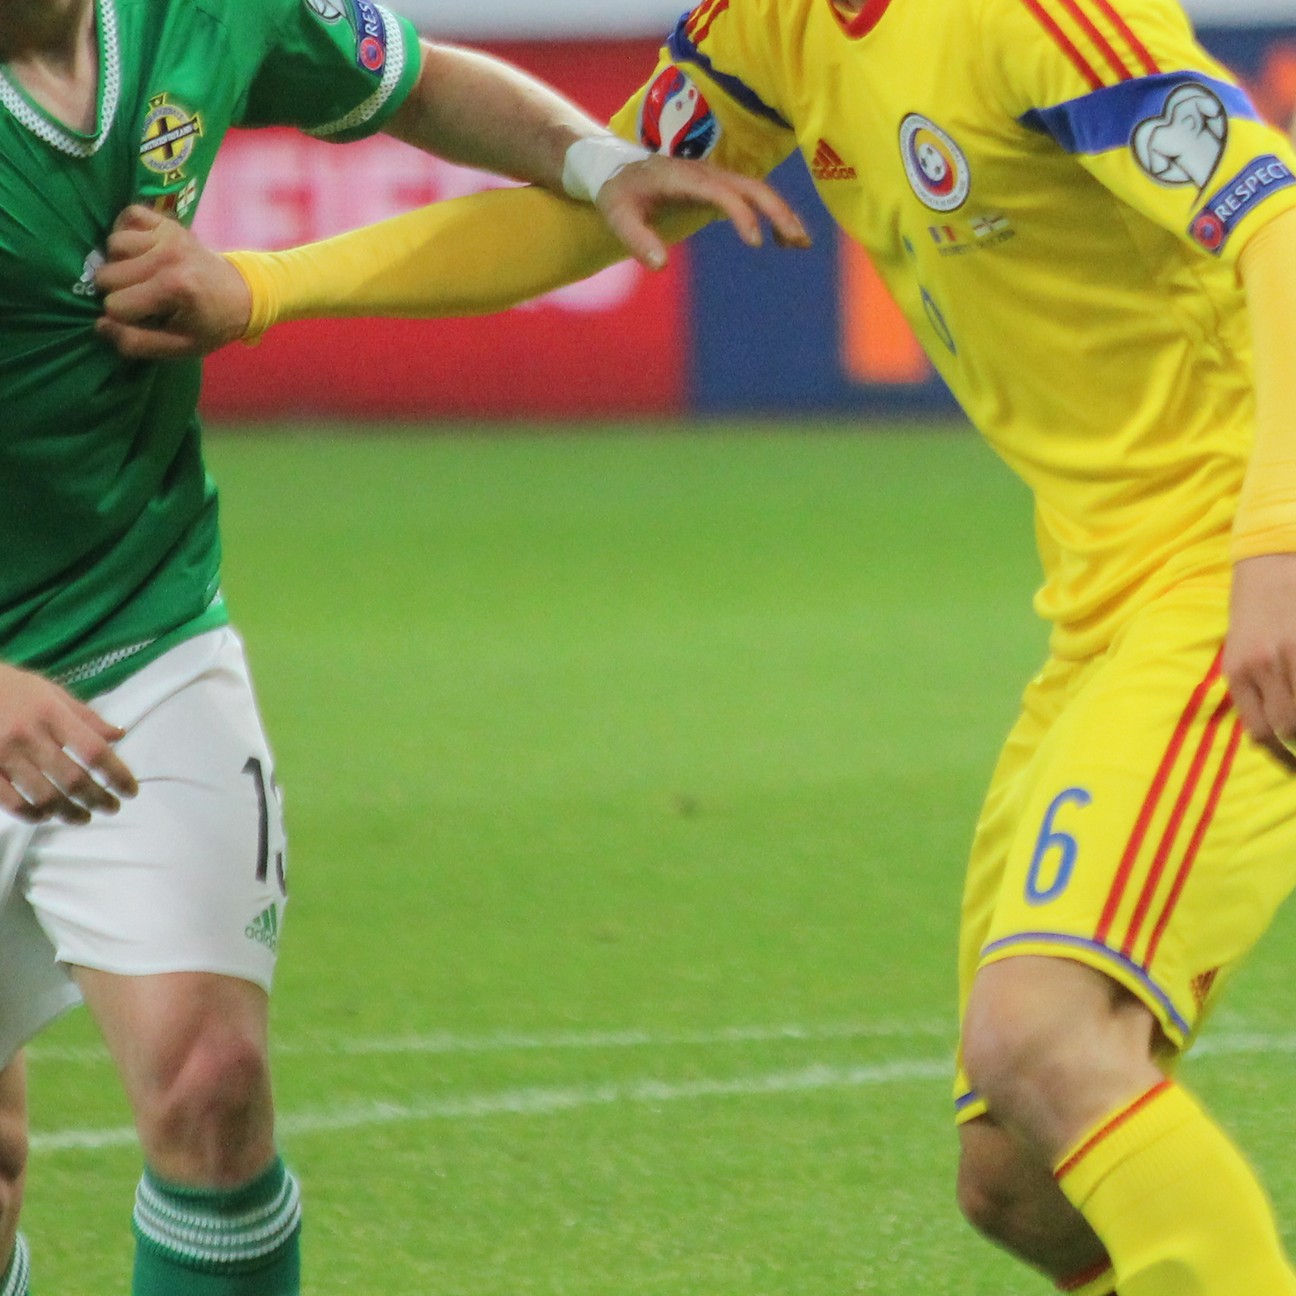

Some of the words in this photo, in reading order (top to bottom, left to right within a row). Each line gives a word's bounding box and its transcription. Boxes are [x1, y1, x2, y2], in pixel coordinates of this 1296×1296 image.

[1213, 160, 1290, 223] RESPECT
[240, 755, 288, 898] 1
[1024, 786, 1093, 908] 6
